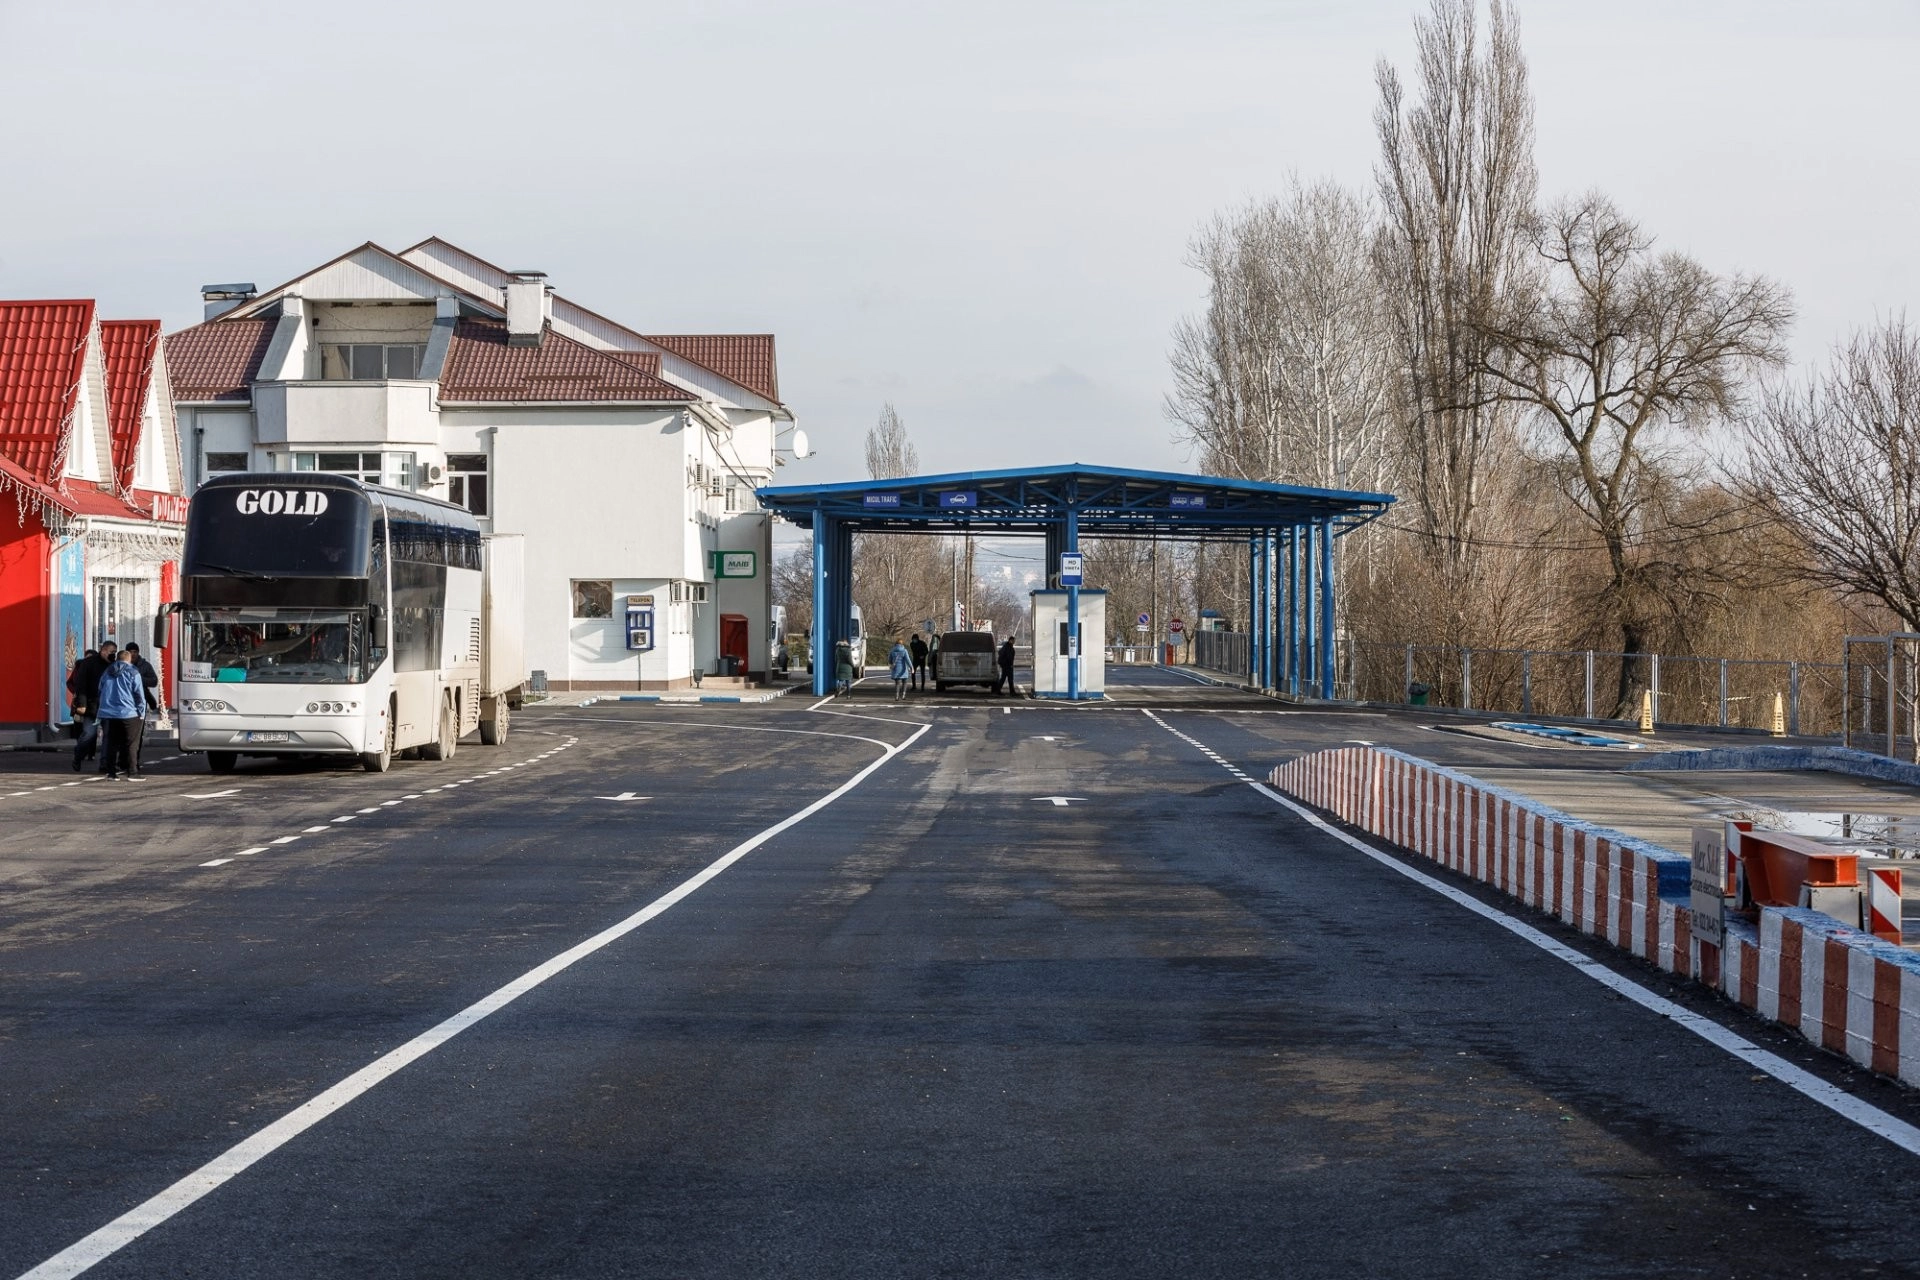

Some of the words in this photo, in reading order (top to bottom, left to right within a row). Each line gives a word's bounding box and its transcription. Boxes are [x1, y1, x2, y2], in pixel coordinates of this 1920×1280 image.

[236, 489, 329, 516] GOLD
[866, 495, 880, 503] MICUL
[881, 495, 897, 503] TRAFIC
[1170, 622, 1183, 630] STOP
